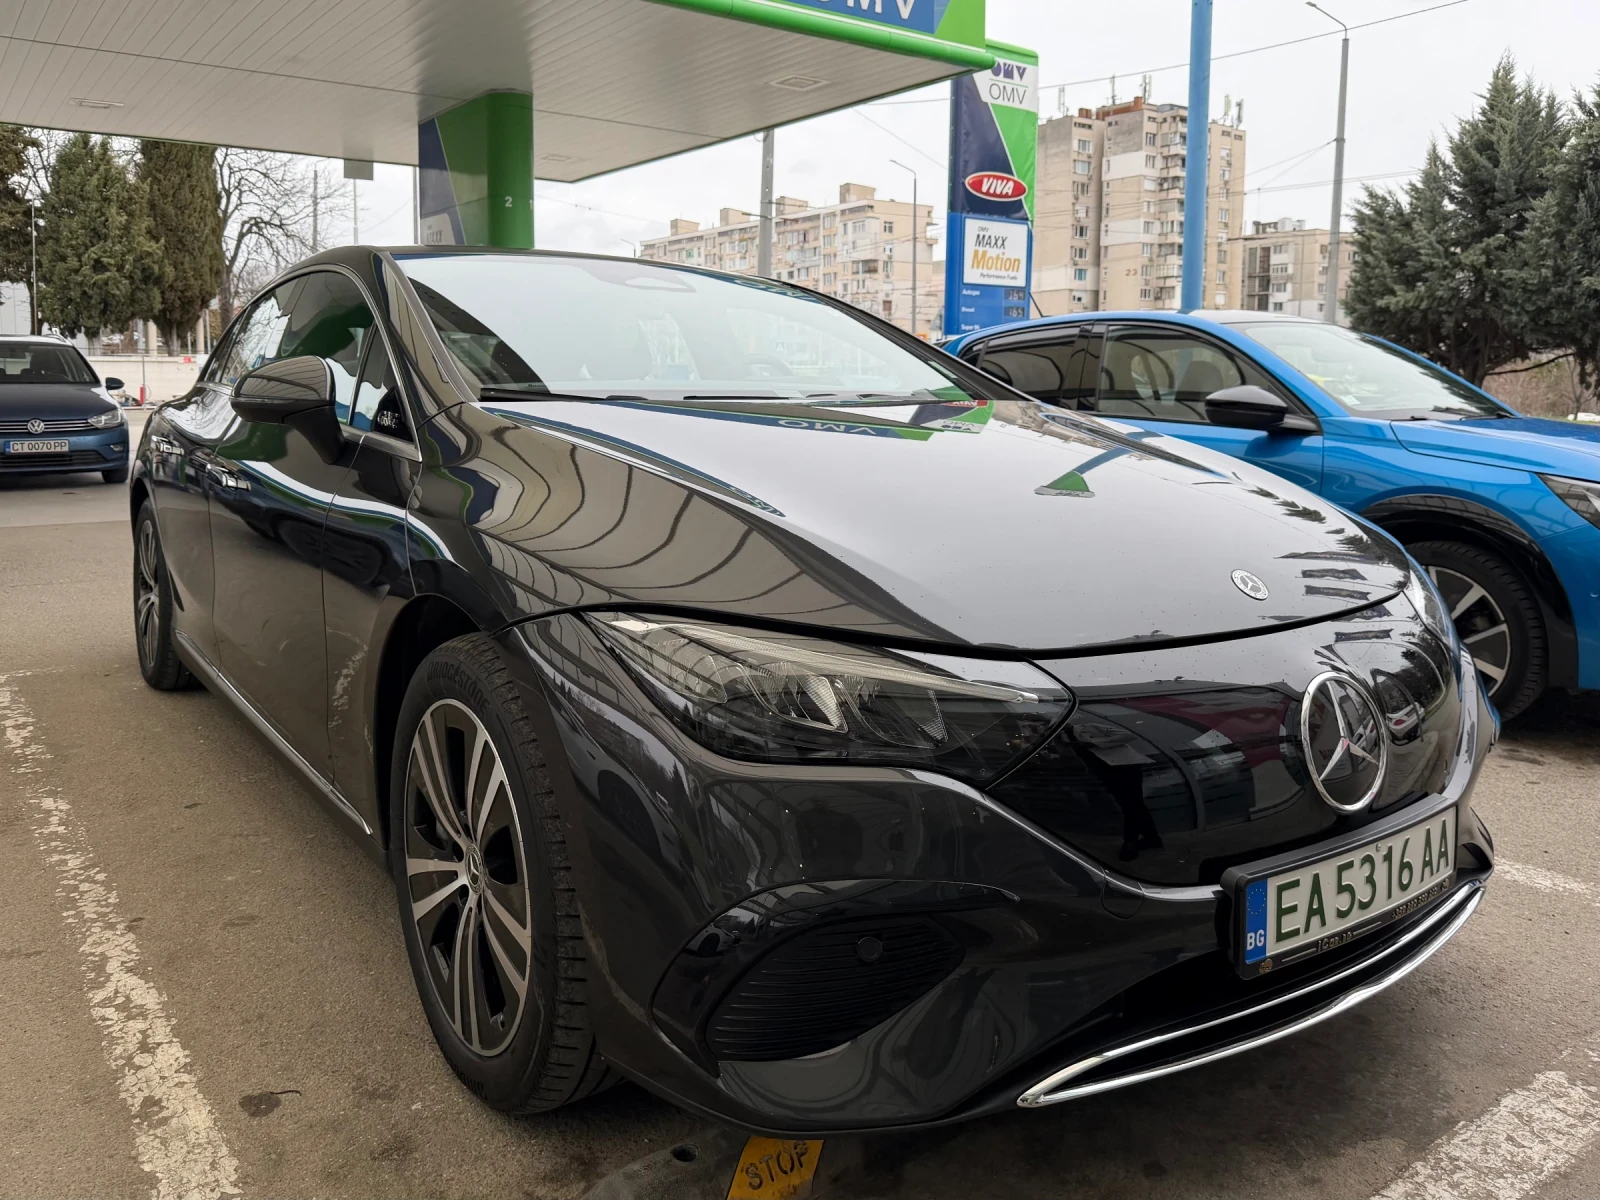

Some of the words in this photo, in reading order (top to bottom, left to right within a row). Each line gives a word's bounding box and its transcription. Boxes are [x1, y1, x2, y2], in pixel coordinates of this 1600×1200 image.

[989, 83, 1026, 104] OMV
[981, 177, 1015, 196] VIVA
[505, 196, 513, 207] 2
[974, 233, 1008, 250] MAXX
[971, 249, 1022, 273] Motion
[11, 442, 25, 451] CT
[28, 442, 52, 451] 0070
[53, 441, 67, 450] PP
[1275, 871, 1327, 943] EA
[1336, 835, 1414, 919] 5316
[1419, 818, 1450, 884] AA
[1246, 929, 1265, 950] BG
[745, 1140, 809, 1190] STOP
